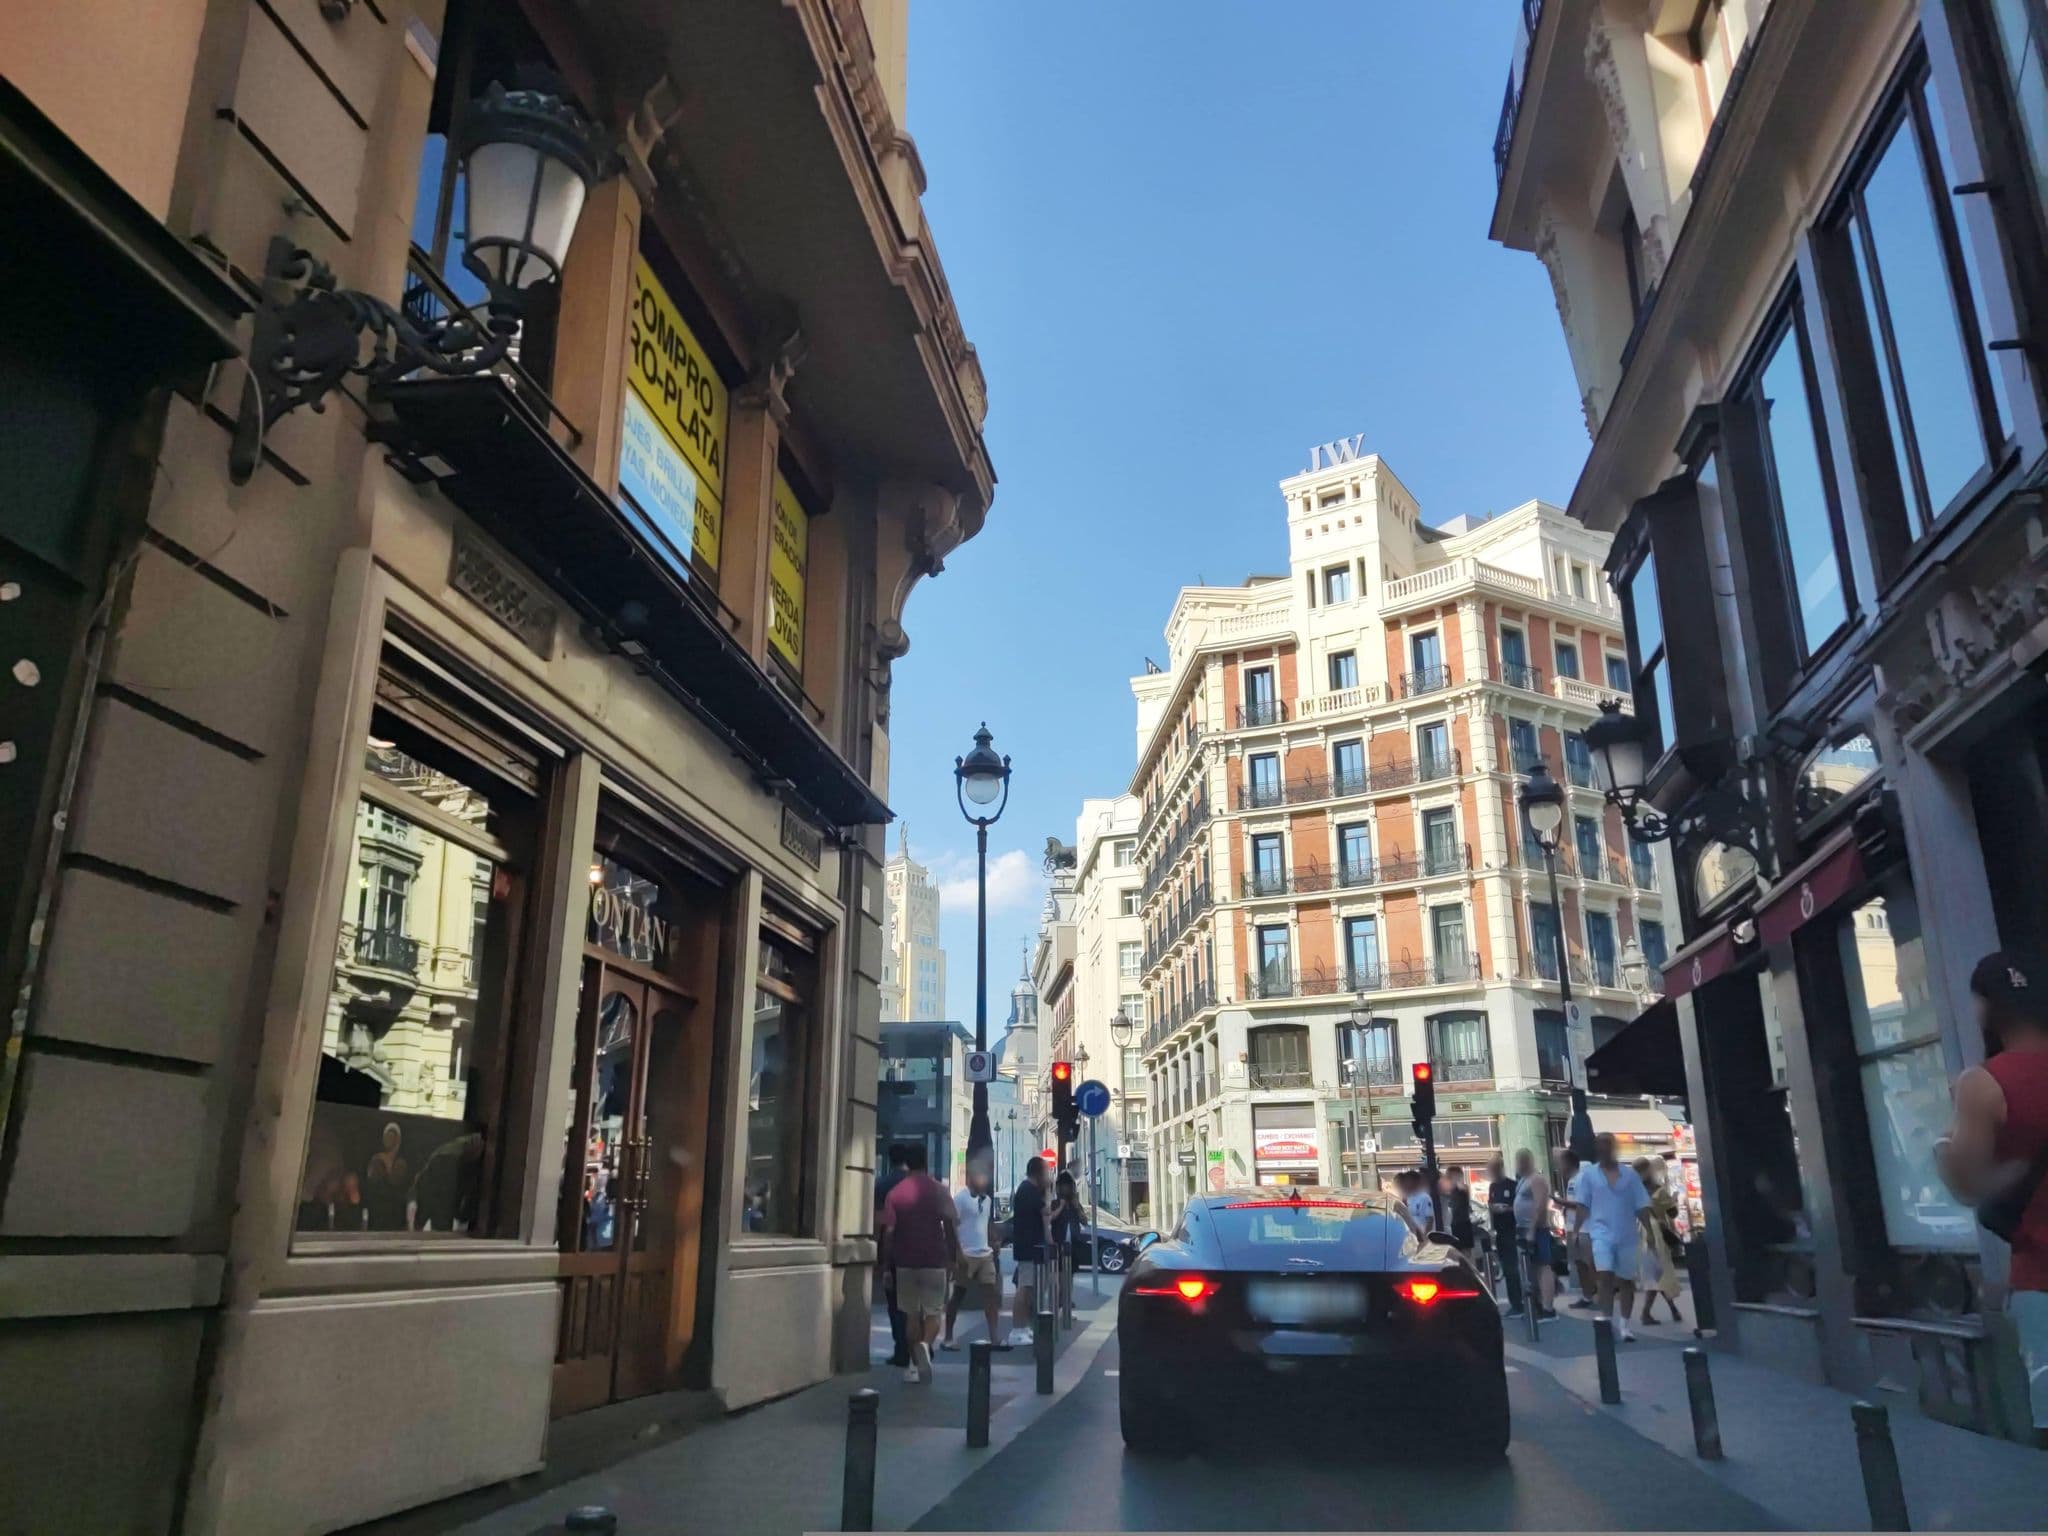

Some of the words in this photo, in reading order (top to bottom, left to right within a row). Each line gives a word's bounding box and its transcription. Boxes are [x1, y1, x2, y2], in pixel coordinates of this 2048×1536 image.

[1299, 432, 1365, 475] JW
[774, 611, 799, 656] OYAS
[586, 885, 674, 957] ONTAN
